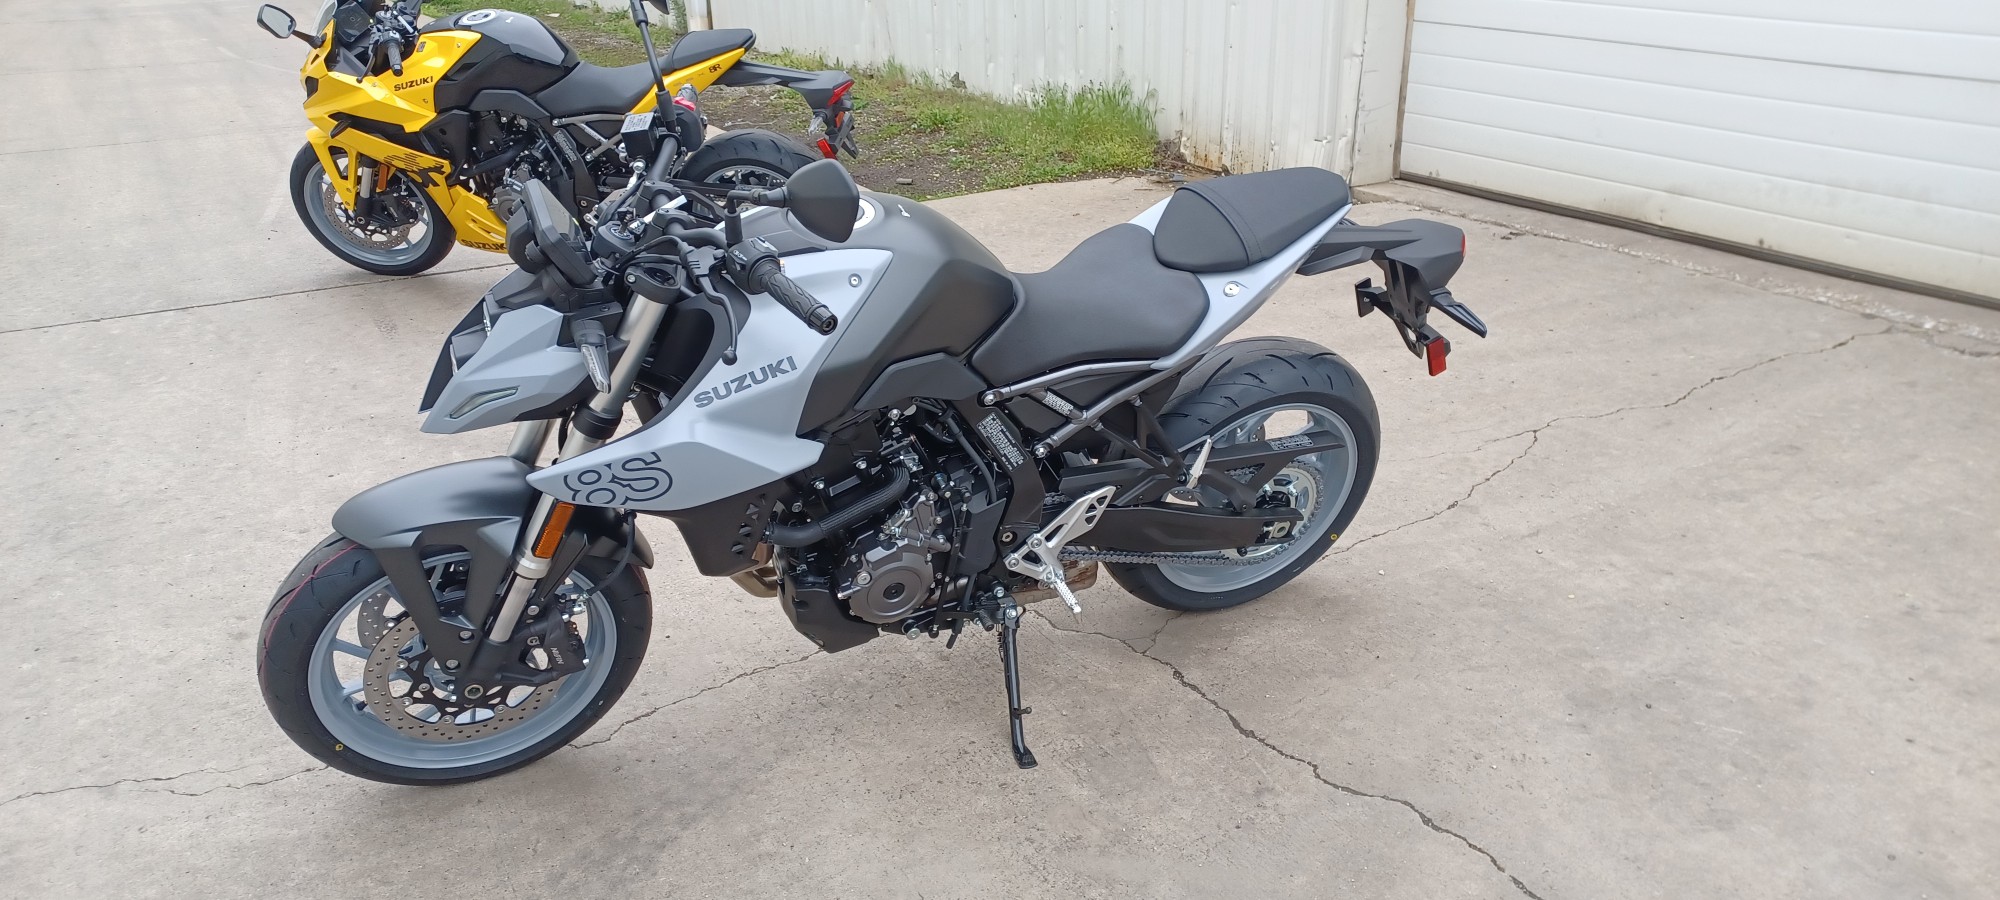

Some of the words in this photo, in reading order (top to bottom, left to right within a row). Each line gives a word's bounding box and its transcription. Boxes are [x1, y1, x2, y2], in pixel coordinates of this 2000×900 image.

[708, 63, 723, 74] 8R
[393, 75, 434, 92] SUZUKI
[460, 238, 507, 251] SUZUK
[693, 355, 798, 408] SUZUKI
[563, 451, 673, 506] 8S
